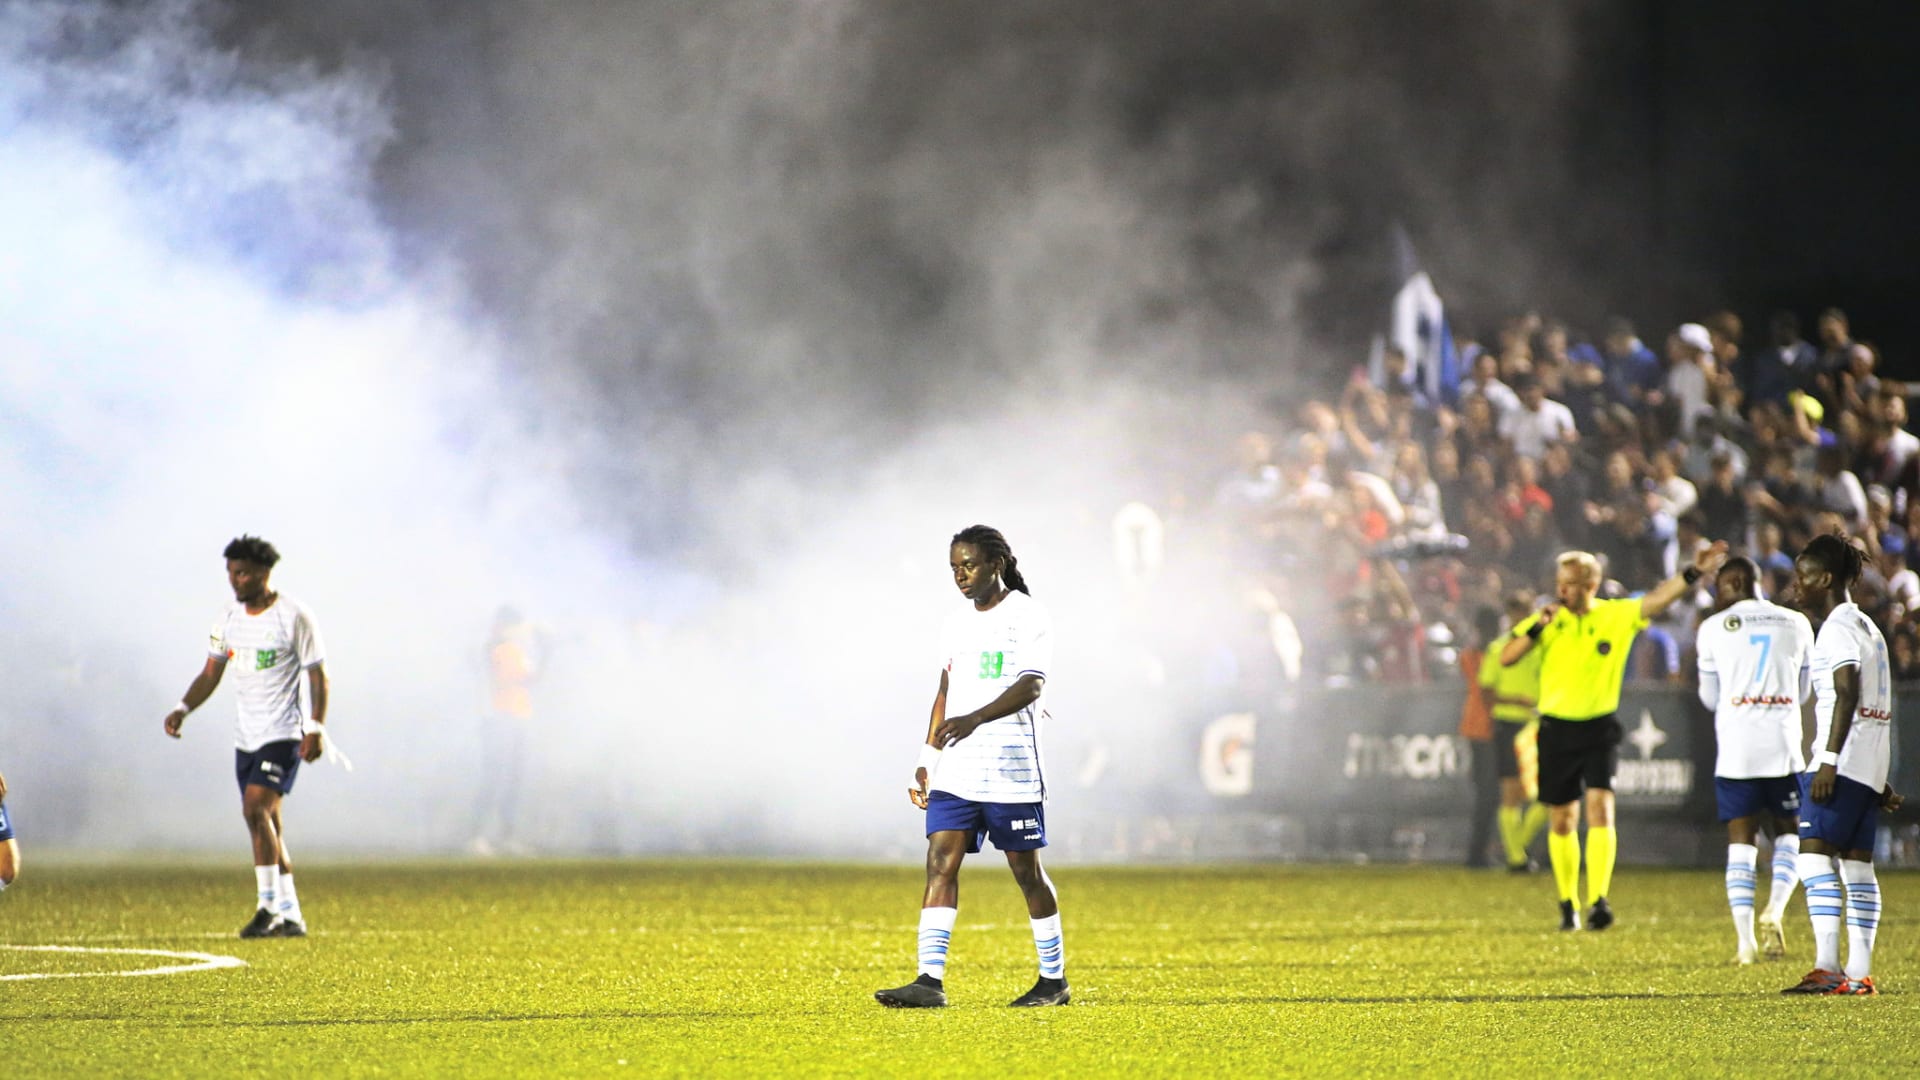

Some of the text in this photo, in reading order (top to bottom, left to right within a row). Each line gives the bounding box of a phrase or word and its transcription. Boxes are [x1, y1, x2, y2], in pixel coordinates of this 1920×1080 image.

[979, 651, 1003, 679] 99
[1749, 635, 1771, 682] 7
[1731, 695, 1792, 706] CANADIAN
[1199, 713, 1255, 796] G
